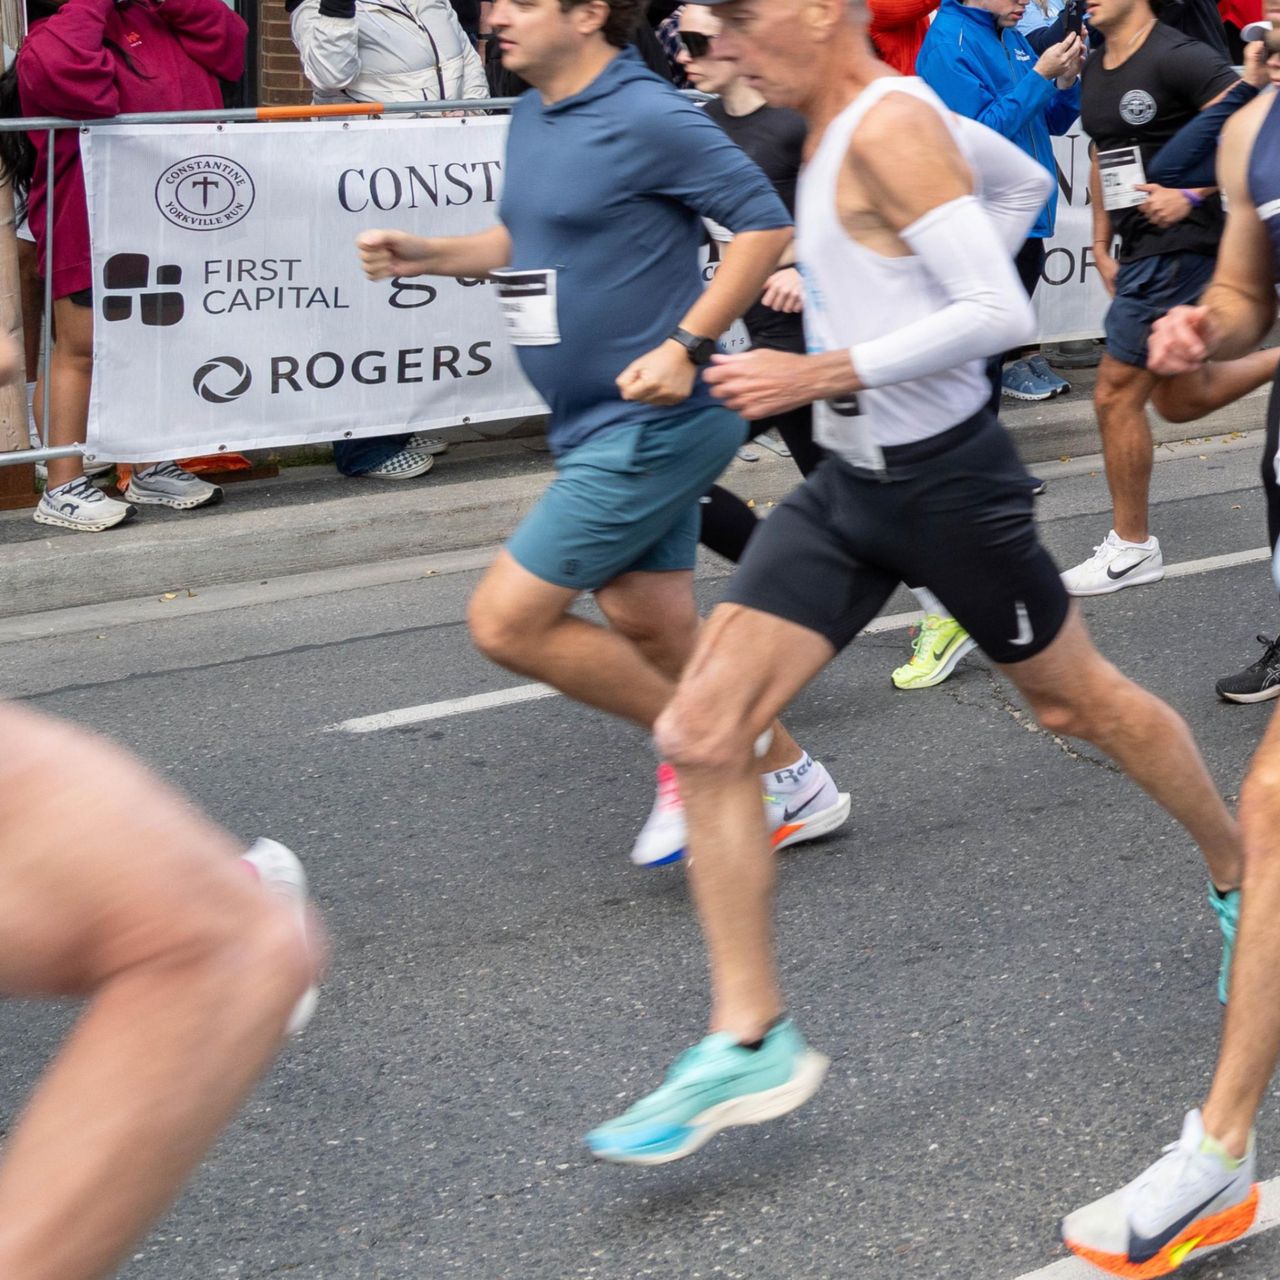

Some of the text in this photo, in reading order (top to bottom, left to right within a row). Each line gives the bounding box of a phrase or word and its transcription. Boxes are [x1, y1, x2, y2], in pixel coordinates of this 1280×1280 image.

[165, 161, 246, 186] CONSTANTINE
[338, 160, 502, 213] CONST
[165, 201, 245, 226] YORKVILLE RUN
[204, 259, 302, 285] FIRST
[202, 286, 350, 315] CAPITAL
[270, 341, 493, 394] ROGERS
